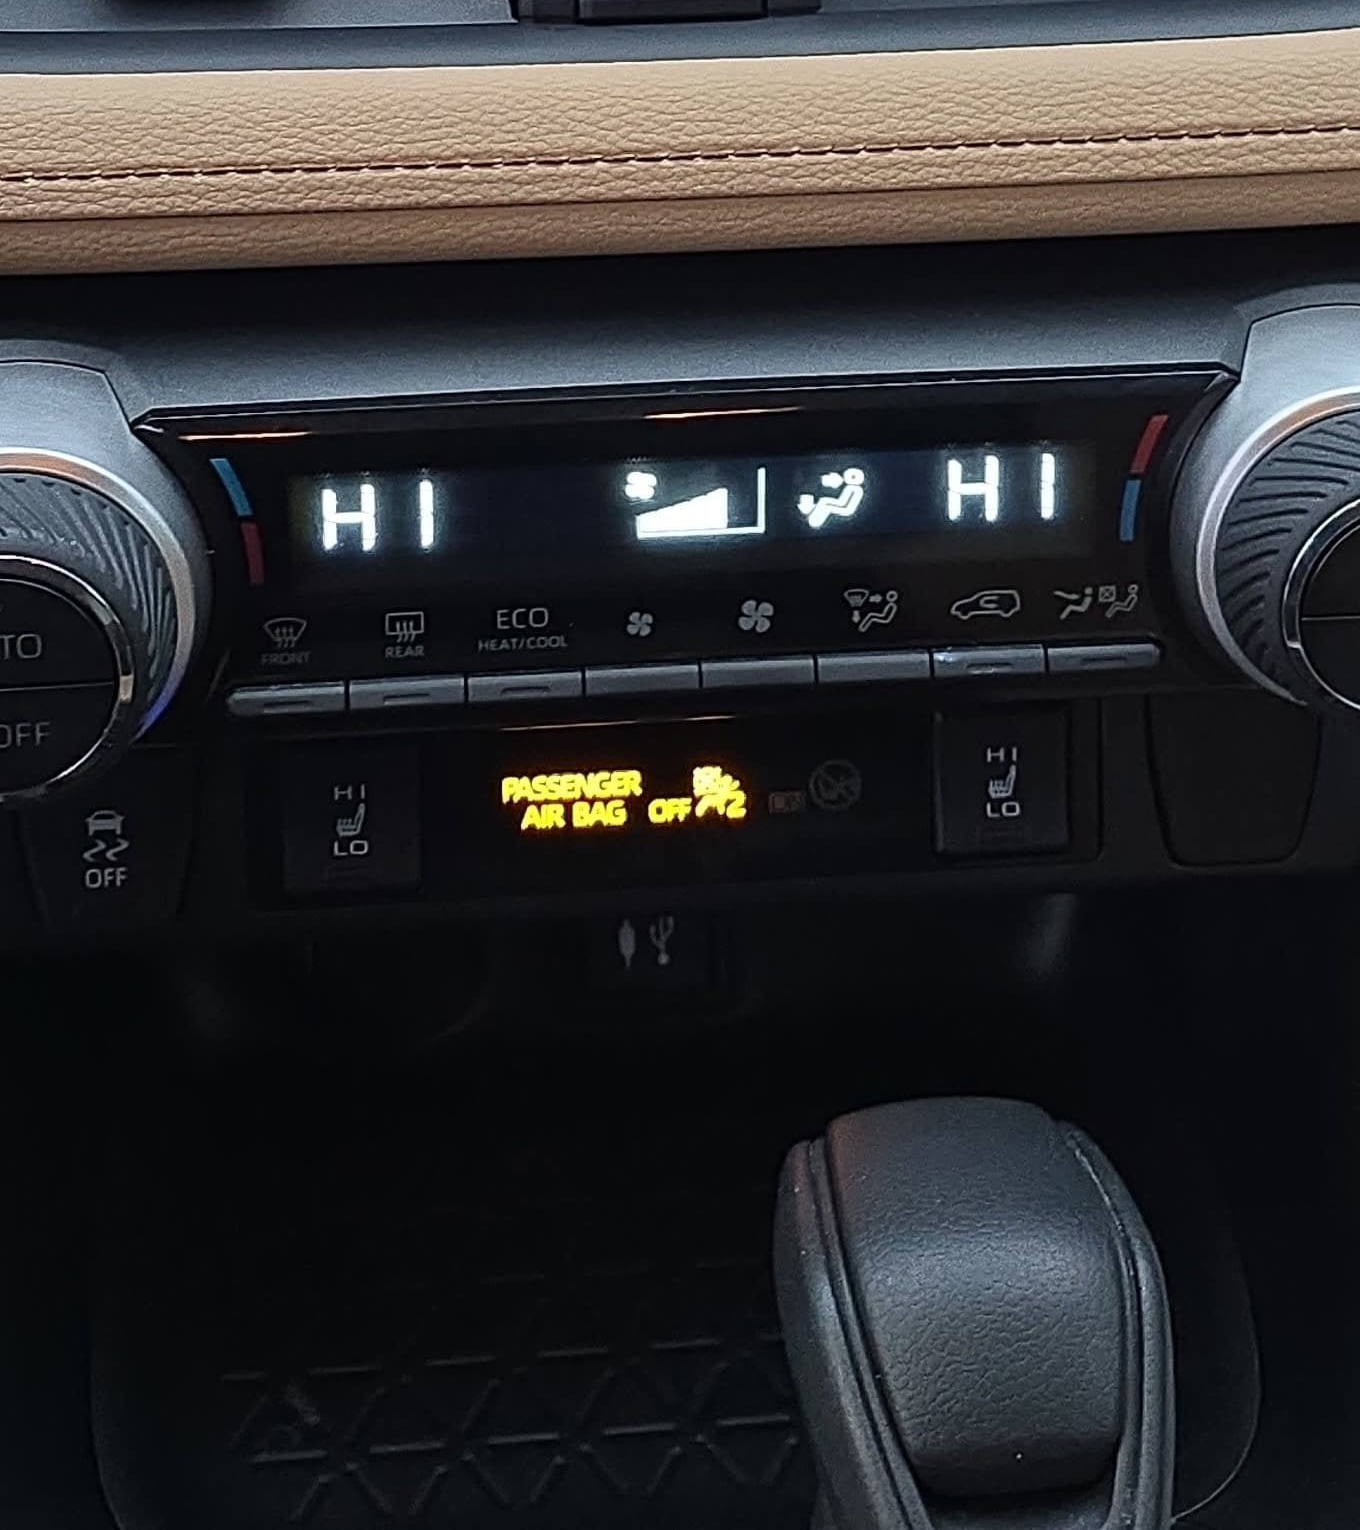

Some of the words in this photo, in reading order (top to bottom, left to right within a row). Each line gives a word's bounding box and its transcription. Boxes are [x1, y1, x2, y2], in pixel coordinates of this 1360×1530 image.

[947, 452, 1056, 523] HI
[321, 479, 435, 552] HI
[496, 607, 549, 630] ECO
[385, 644, 425, 659] REAR
[478, 635, 568, 651] HEAT/COOL
[261, 651, 311, 665] FRONT
[986, 747, 1017, 763] HI
[333, 784, 366, 801] HI
[501, 769, 643, 803] PASSENGER
[520, 803, 567, 831] AIR
[572, 799, 628, 828] BAG
[647, 797, 693, 824] OFF
[986, 801, 1021, 818] LO
[333, 839, 369, 856] LO
[85, 866, 127, 889] OFF
